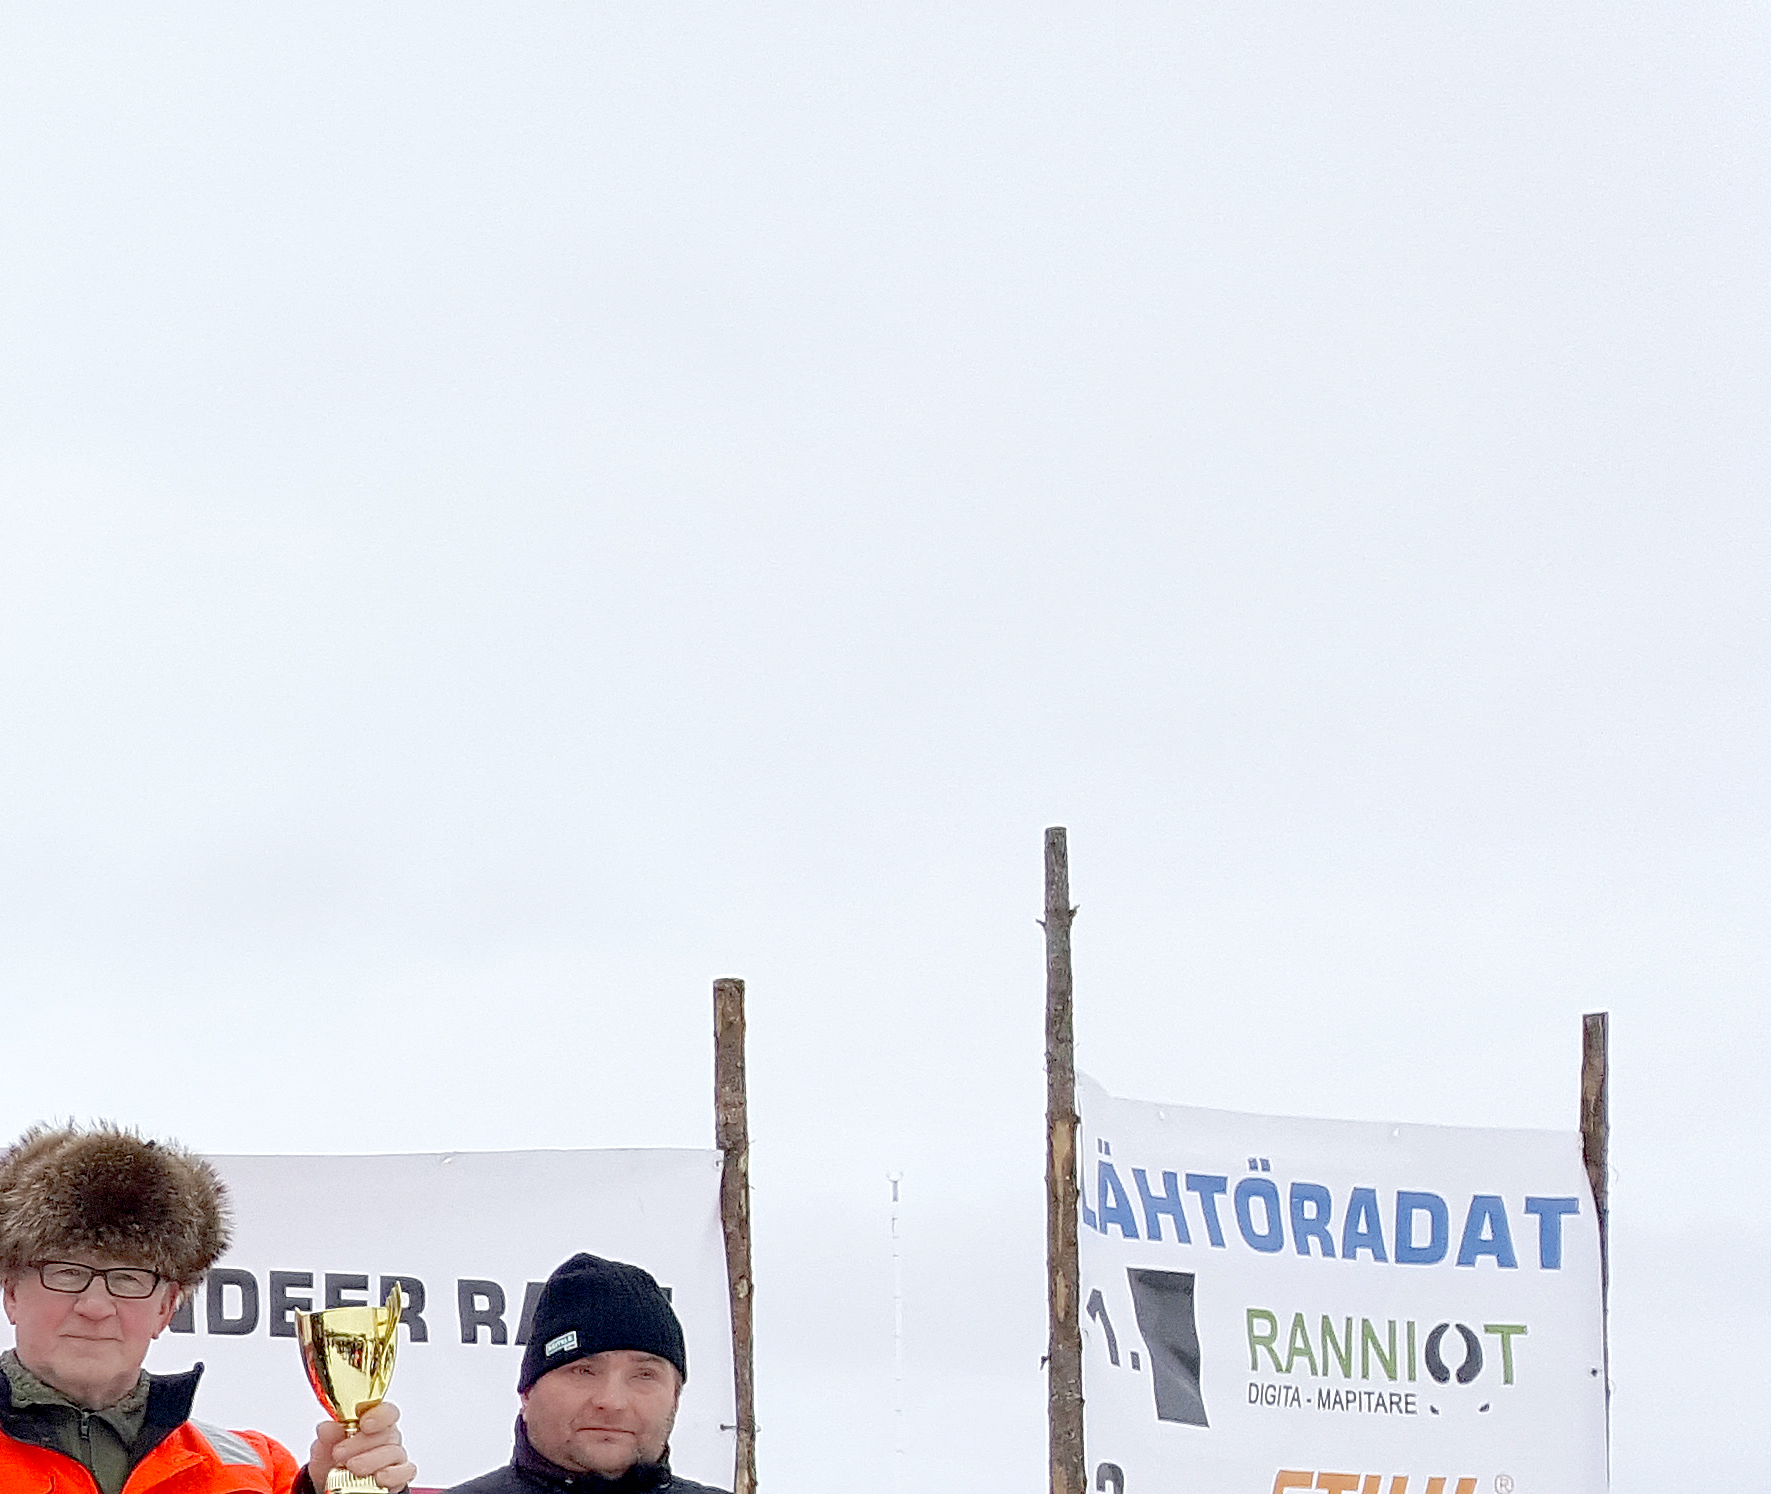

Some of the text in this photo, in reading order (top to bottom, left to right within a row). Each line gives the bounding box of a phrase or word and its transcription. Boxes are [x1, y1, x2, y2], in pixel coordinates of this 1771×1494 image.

[1085, 1288, 1141, 1371] 1.
[1248, 1382, 1302, 1408] DIGITA
[1317, 1387, 1418, 1415] MAPITARE
